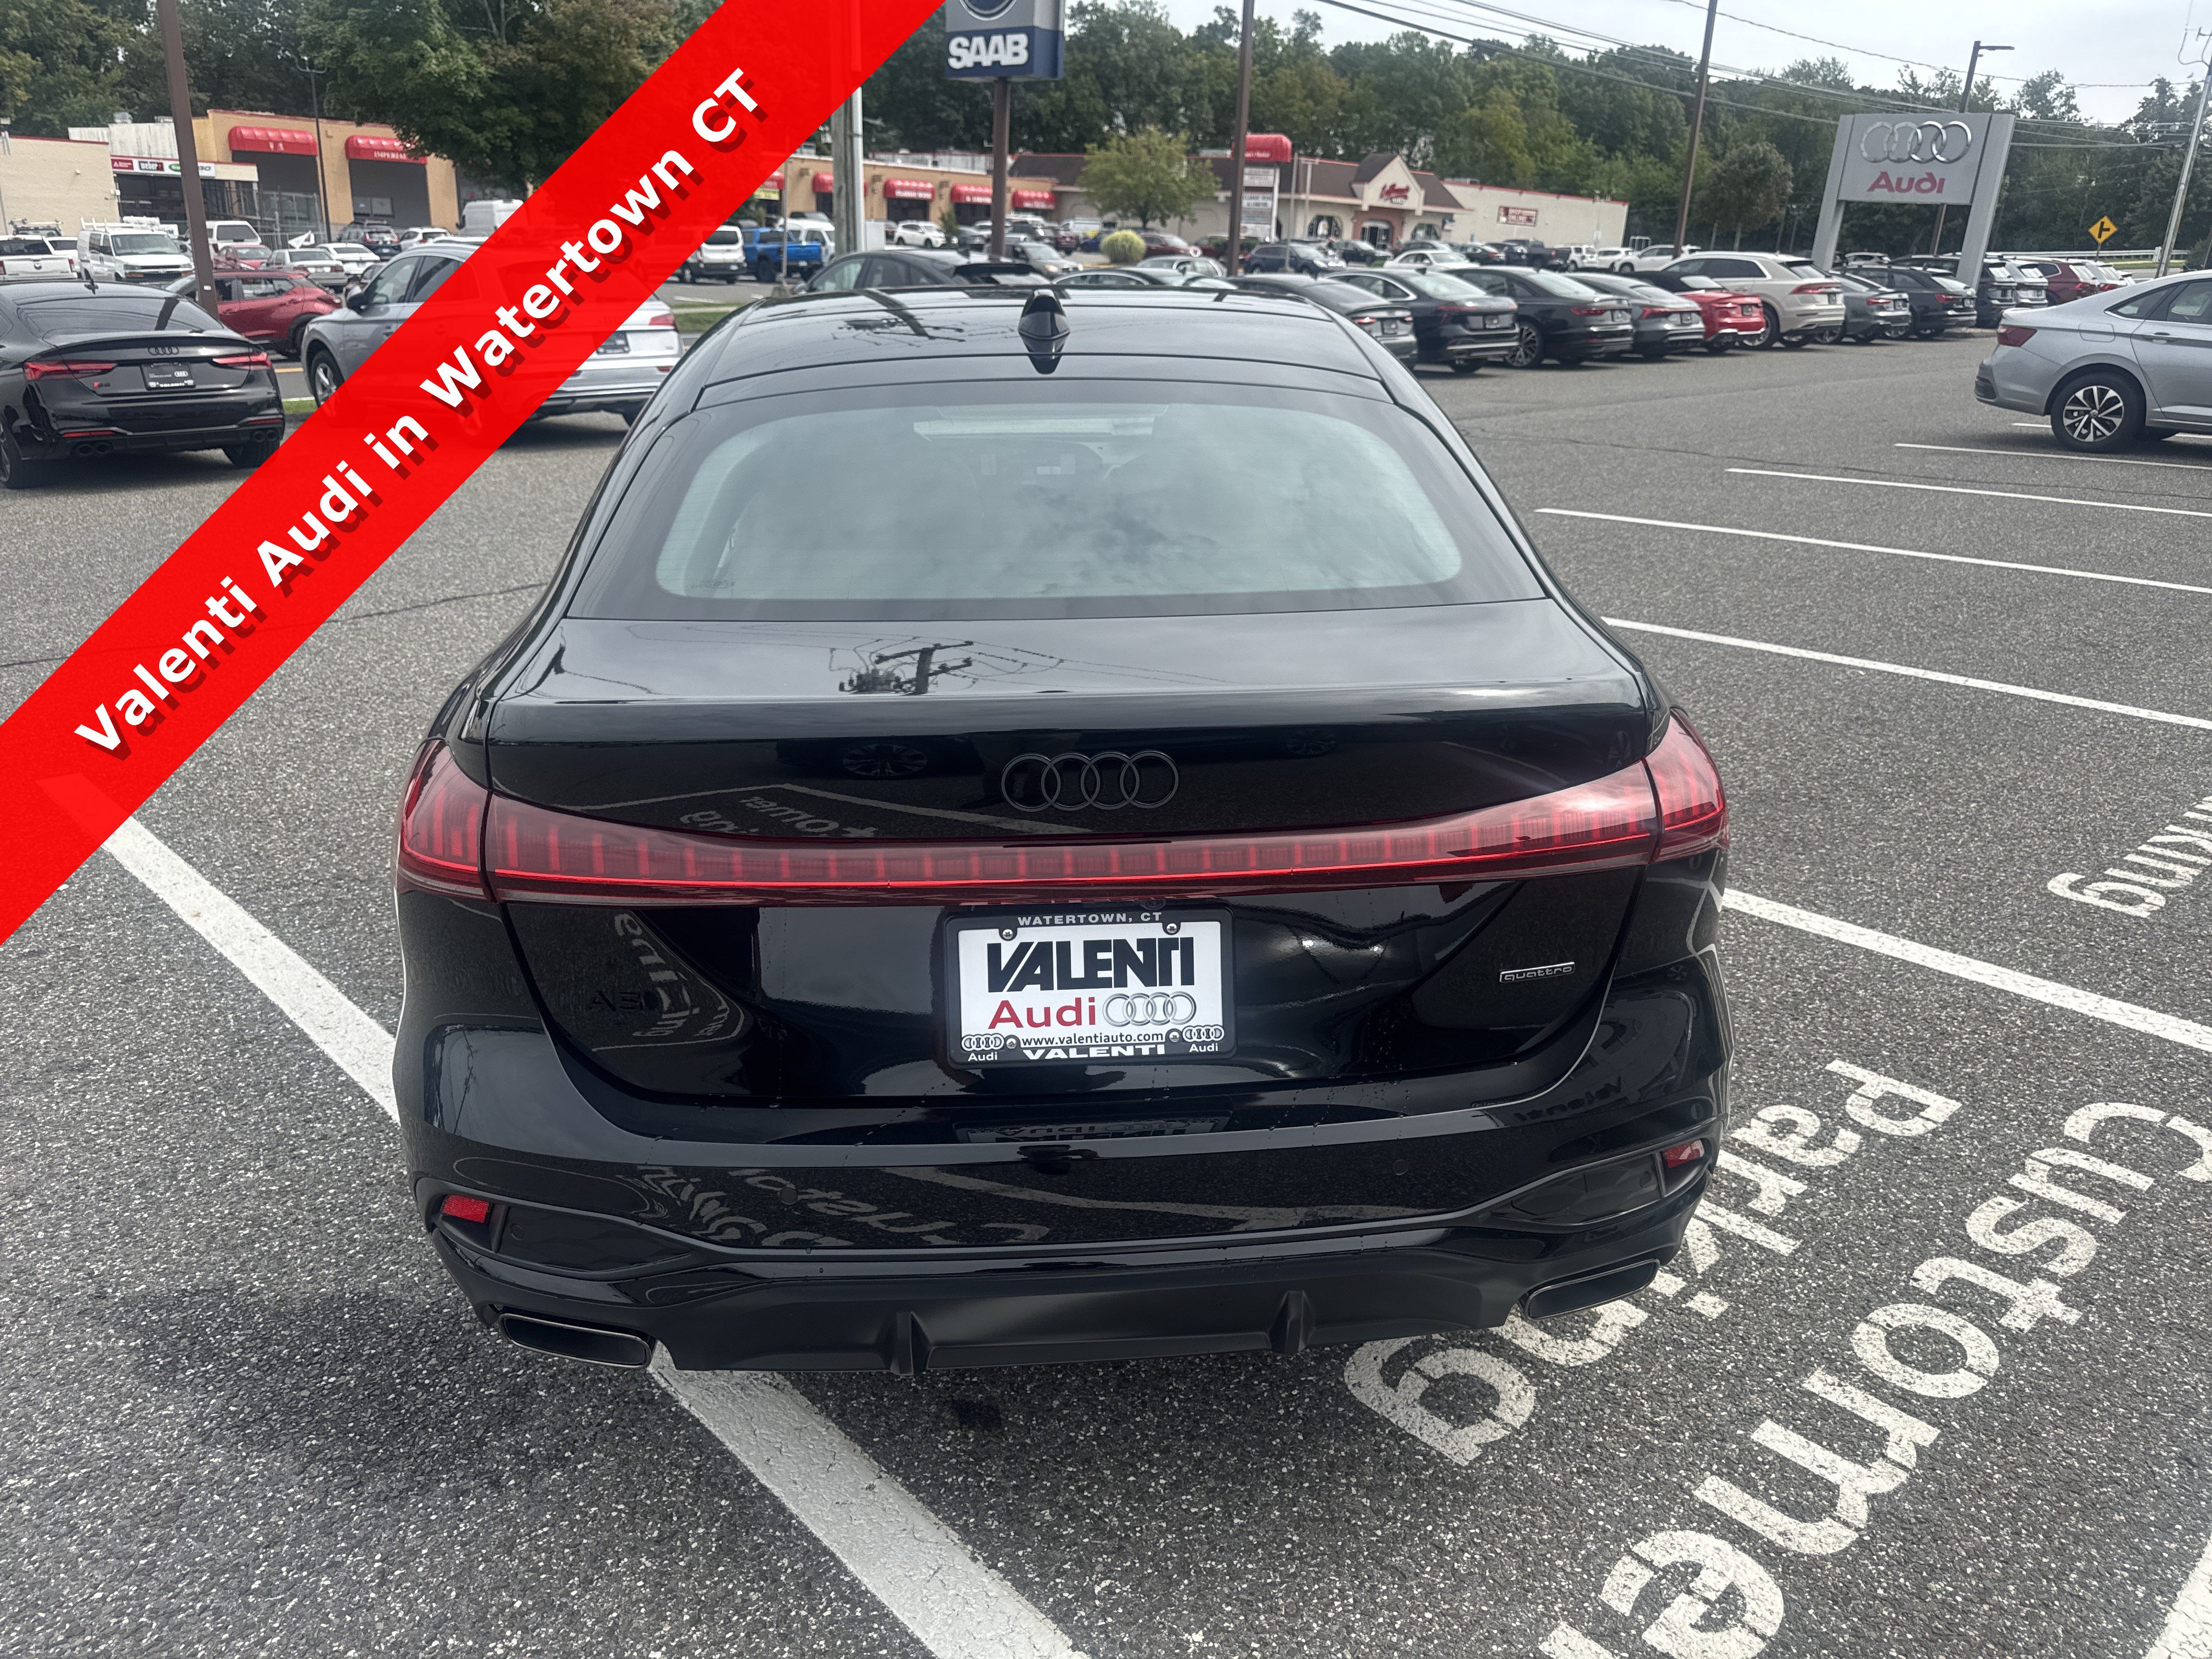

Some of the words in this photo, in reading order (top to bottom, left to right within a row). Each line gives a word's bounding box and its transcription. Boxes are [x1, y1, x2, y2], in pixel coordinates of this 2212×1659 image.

[947, 33, 1029, 69] SAAB
[1867, 171, 1945, 193] Audi
[1018, 913, 1132, 926] WATERTOWN,
[1141, 912, 1162, 921] CT
[988, 937, 1195, 992] VALENTI
[1504, 966, 1572, 981] quattro
[988, 996, 1096, 1029] Audi
[1022, 1031, 1164, 1046] www.valentiauto.com
[1022, 1044, 1165, 1059] VALENTI
[1189, 1043, 1218, 1052] Audi
[968, 1052, 997, 1062] Audi
